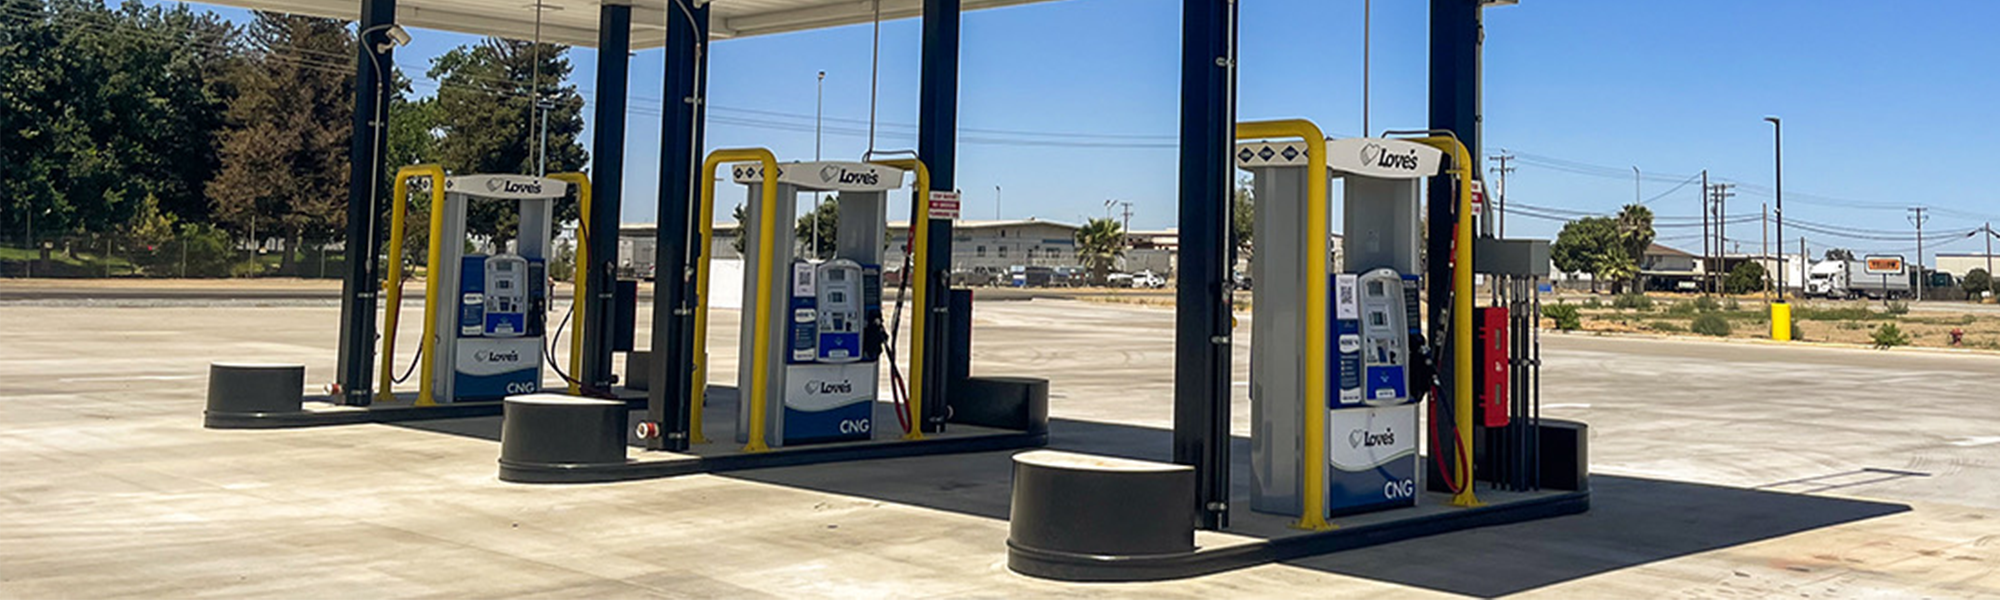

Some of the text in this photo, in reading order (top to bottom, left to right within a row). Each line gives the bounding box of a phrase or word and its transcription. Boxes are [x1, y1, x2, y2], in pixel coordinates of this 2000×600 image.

[1378, 148, 1418, 170] Love's
[839, 168, 878, 185] Love's
[504, 180, 541, 194] Love's
[489, 350, 518, 361] Love's
[506, 382, 535, 394] CNG
[820, 380, 851, 393] Love's
[840, 418, 869, 434] CNG
[1364, 427, 1394, 447] Love's
[1384, 479, 1413, 499] CNG
